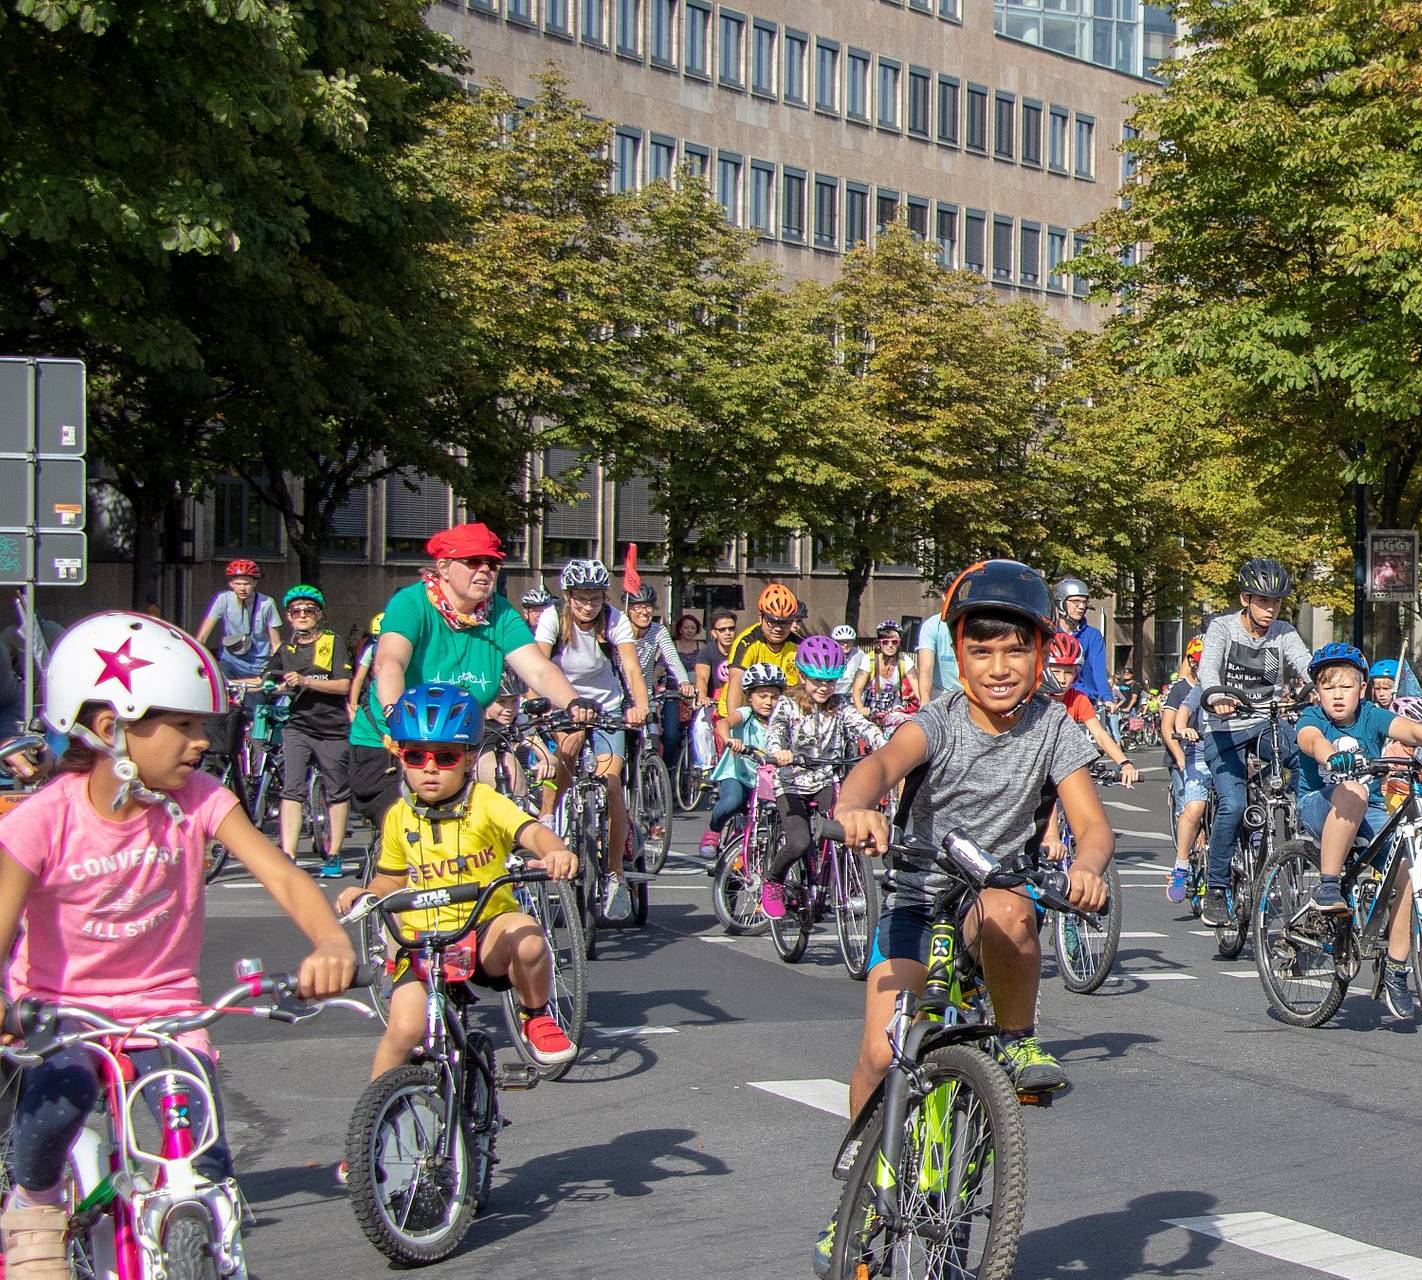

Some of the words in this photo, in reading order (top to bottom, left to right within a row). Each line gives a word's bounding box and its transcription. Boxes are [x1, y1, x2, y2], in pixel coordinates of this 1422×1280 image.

[1228, 662, 1245, 671] BLAH
[1226, 672, 1244, 680] BLAH
[1226, 681, 1243, 690] BLAH
[416, 888, 449, 903] STAR
[82, 919, 120, 938] ALL
